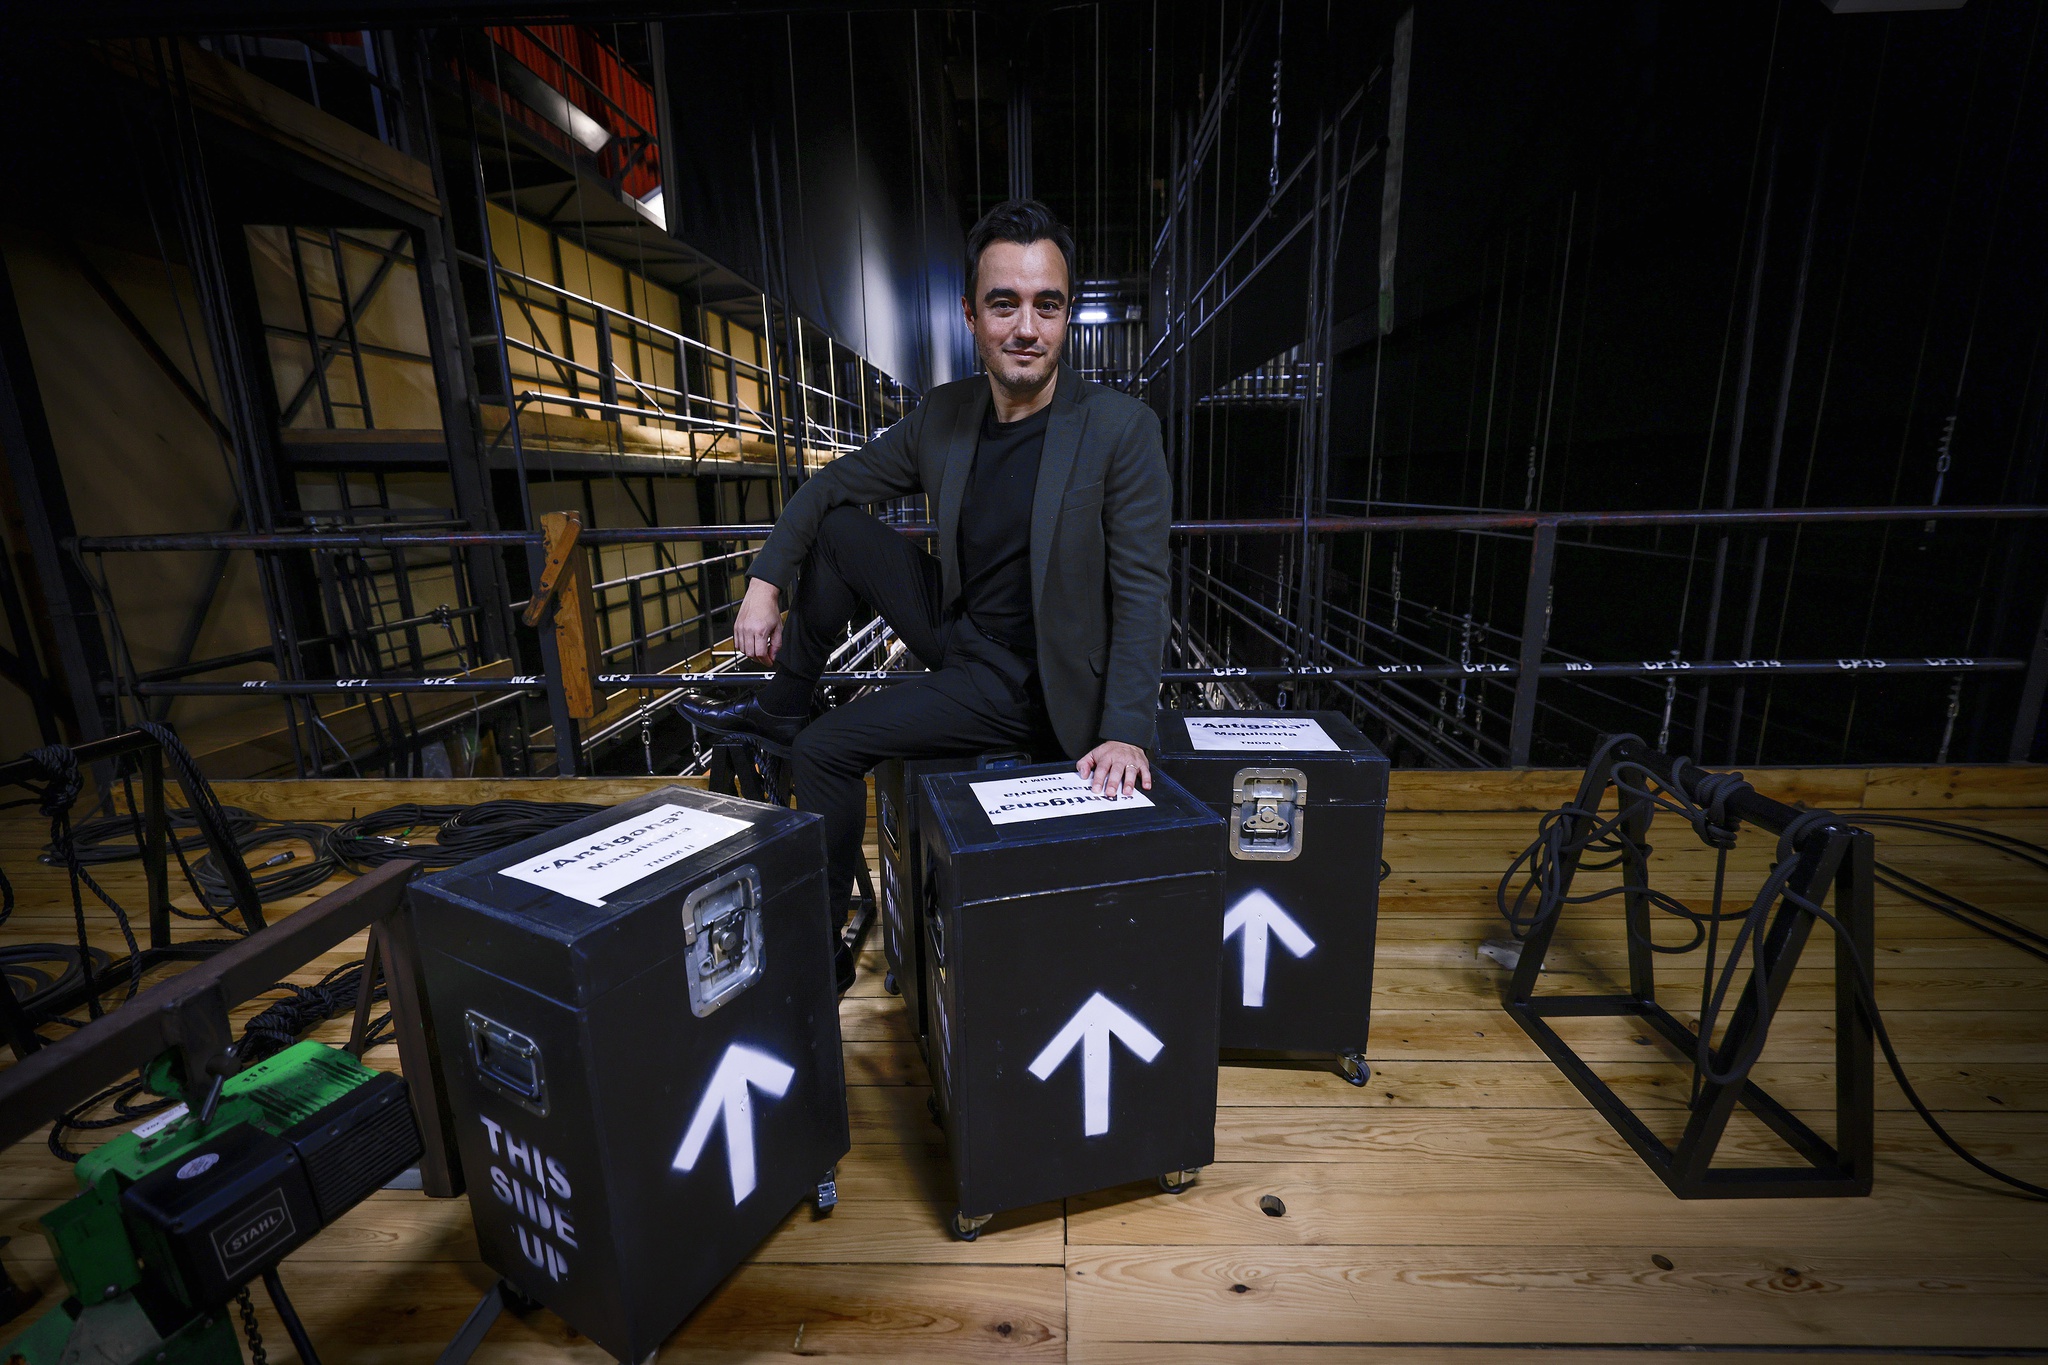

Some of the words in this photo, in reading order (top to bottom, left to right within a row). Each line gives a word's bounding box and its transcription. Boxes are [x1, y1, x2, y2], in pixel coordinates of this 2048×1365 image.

[1213, 668, 1247, 676] CP9
[587, 826, 692, 871] Maquinaria
[644, 850, 685, 867] TNDM
[479, 1113, 572, 1200] THIS
[490, 1165, 579, 1250] SIDE
[232, 1216, 279, 1252] STAHL
[516, 1223, 569, 1283] UP
